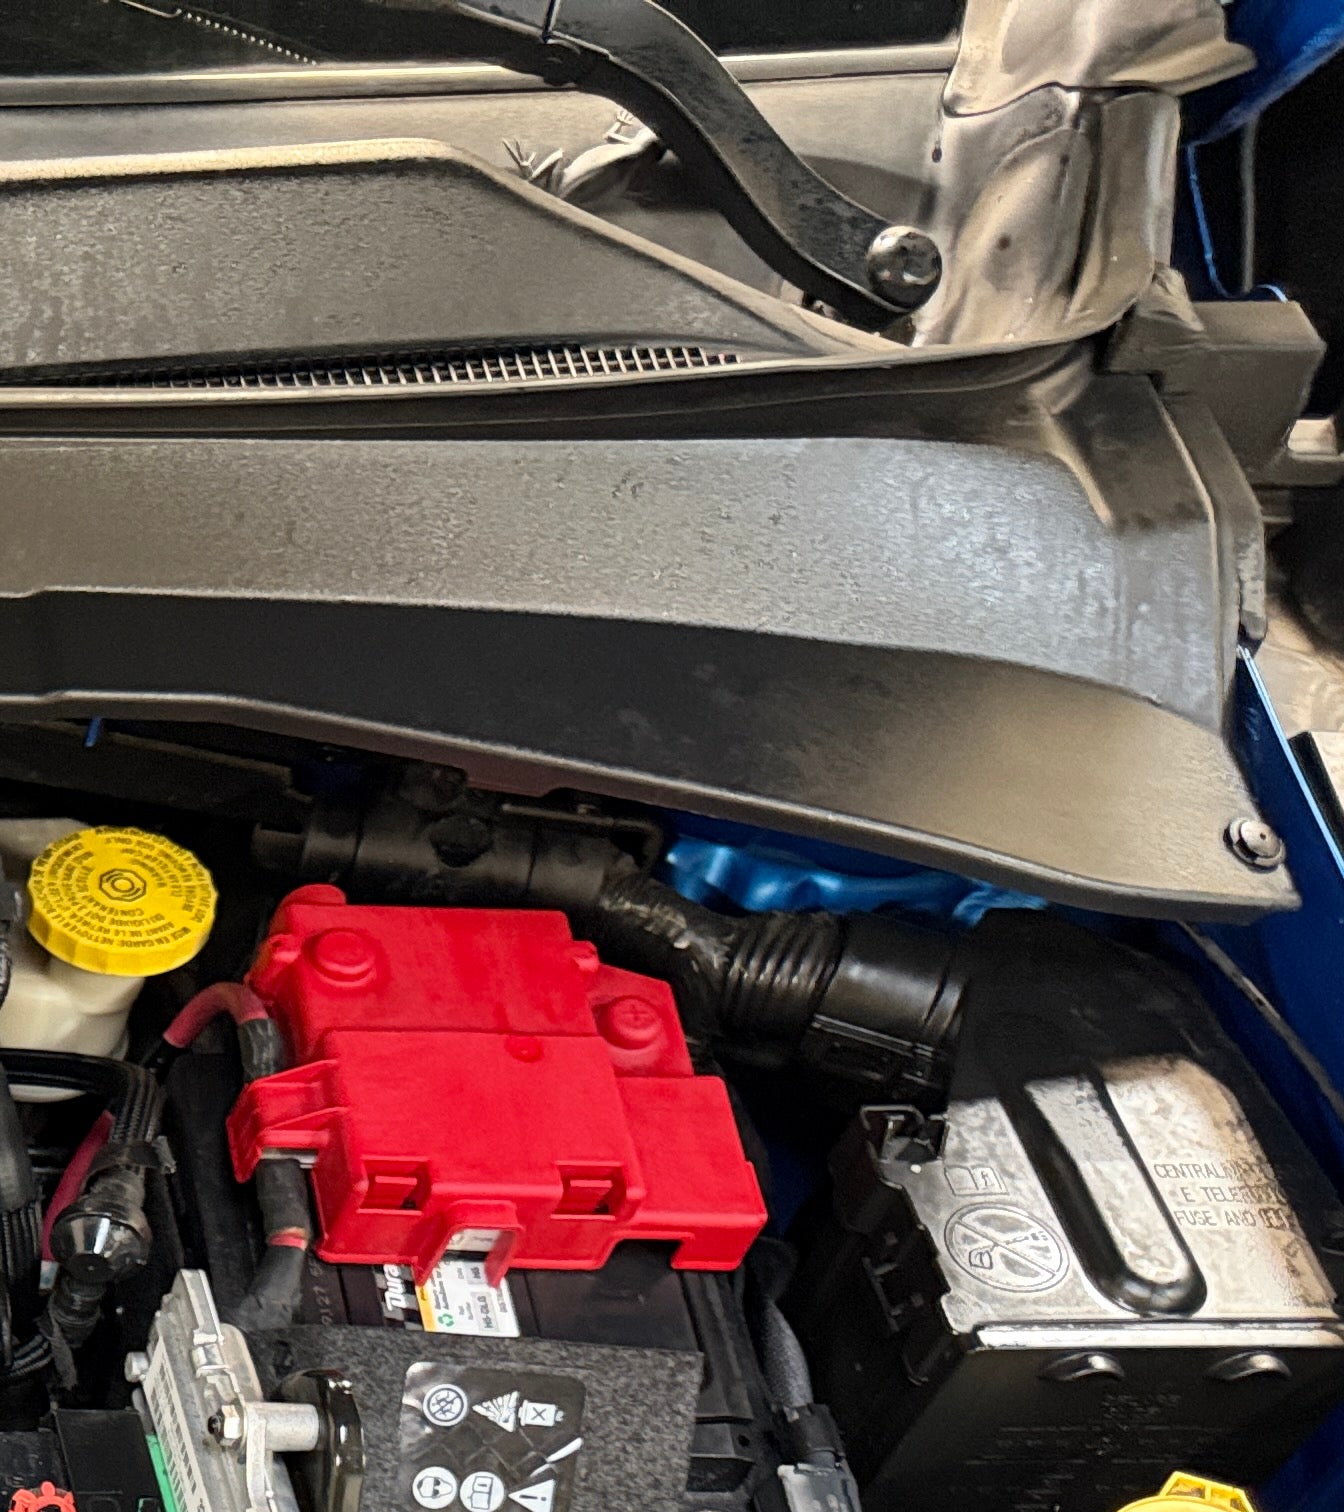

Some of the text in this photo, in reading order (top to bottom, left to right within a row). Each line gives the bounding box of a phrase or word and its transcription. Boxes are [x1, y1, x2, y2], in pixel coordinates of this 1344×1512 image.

[1173, 1210, 1218, 1227] FUSE
[1224, 1211, 1257, 1228] AND
[383, 1264, 407, 1311] Dura
